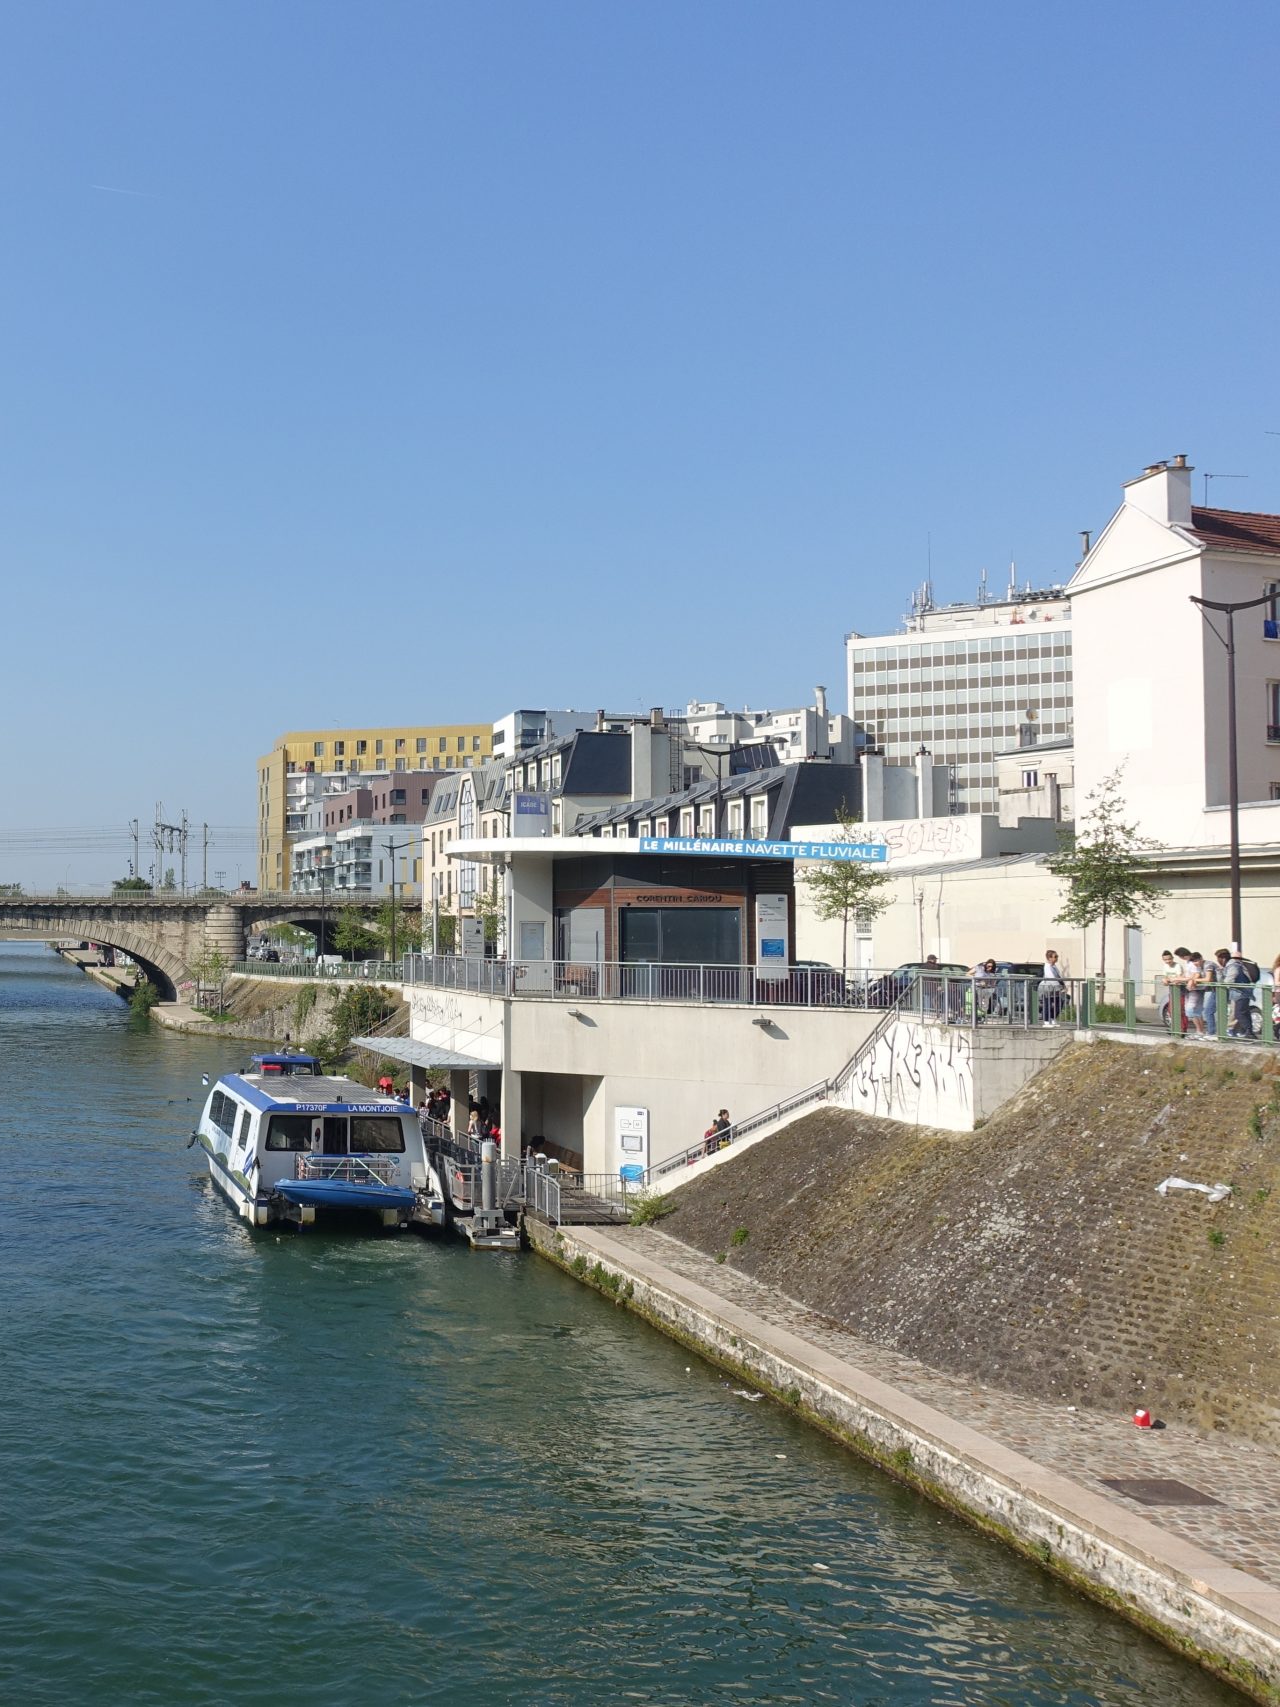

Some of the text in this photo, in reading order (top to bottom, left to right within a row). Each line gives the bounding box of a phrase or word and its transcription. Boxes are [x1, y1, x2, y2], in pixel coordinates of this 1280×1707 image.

[643, 839, 880, 859] LE MILLÉNAIRE NAVETTE FLUVIALE
[636, 895, 722, 903] CORENTIN CARIOU
[296, 1104, 327, 1112] P17370F
